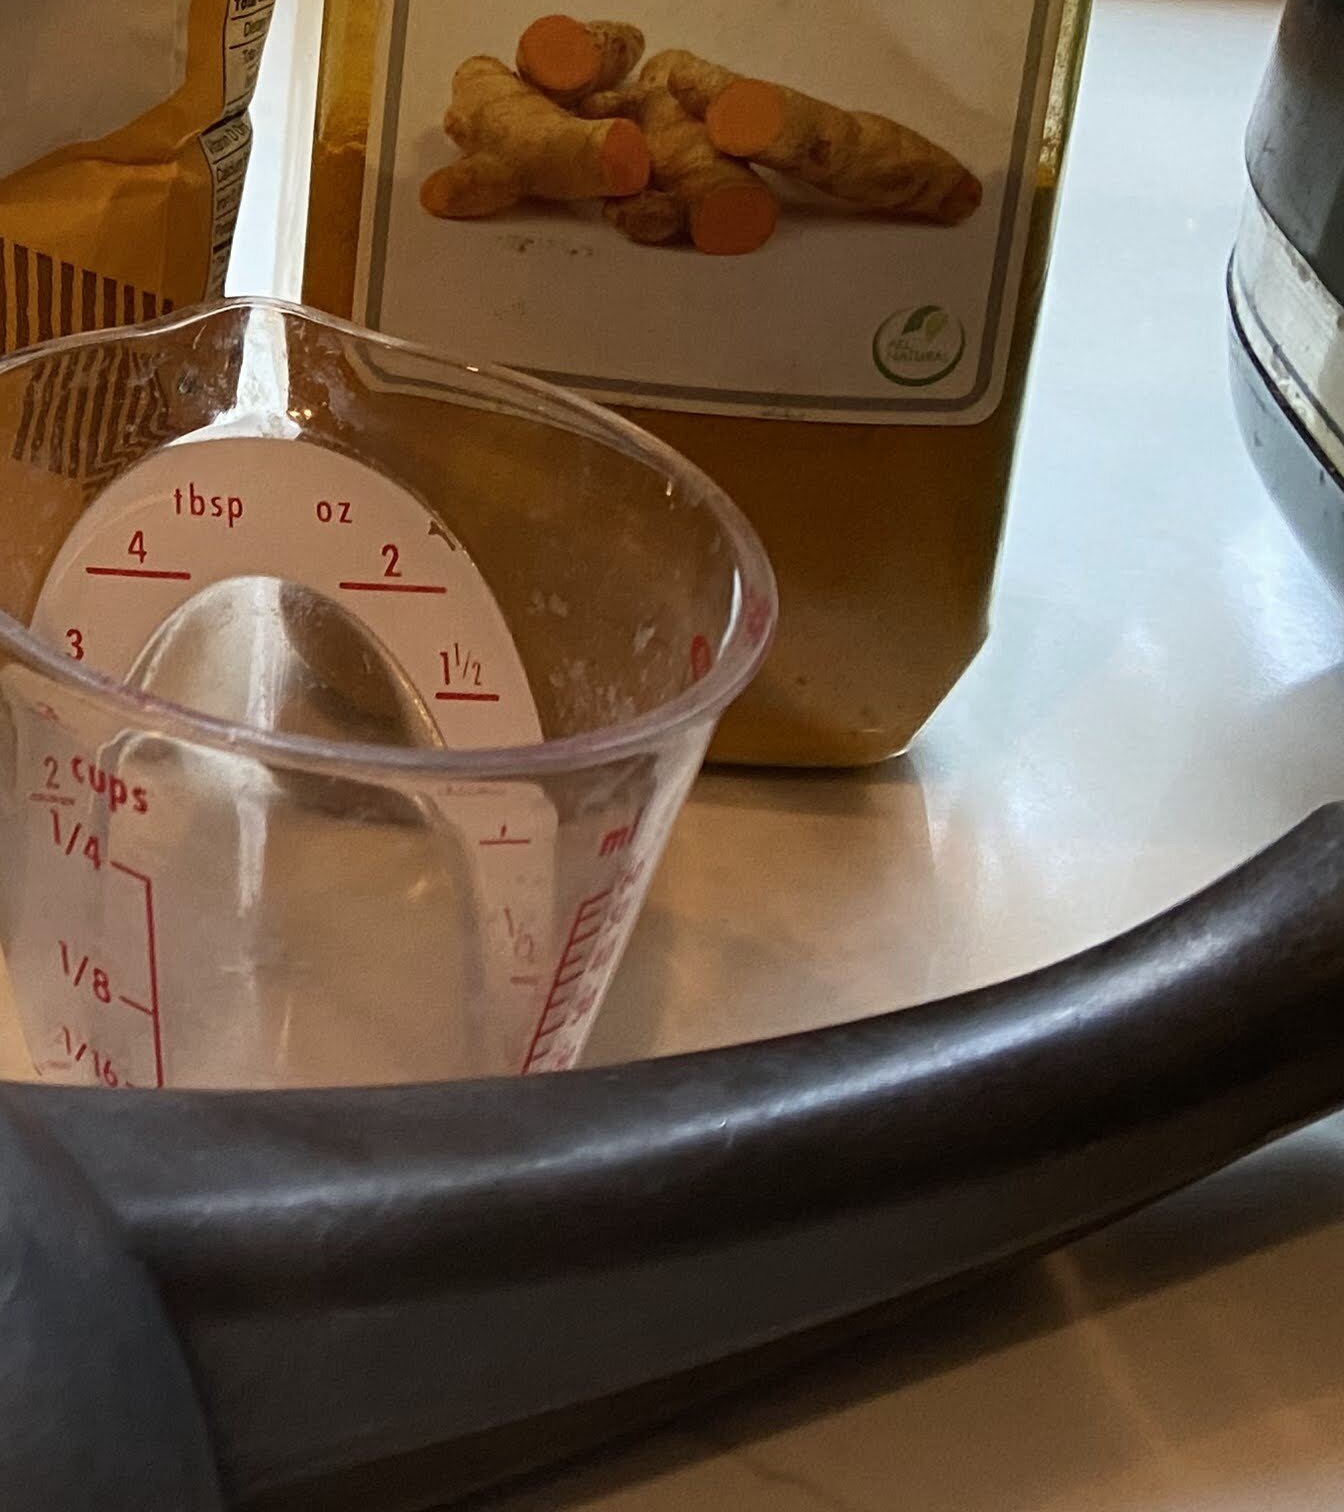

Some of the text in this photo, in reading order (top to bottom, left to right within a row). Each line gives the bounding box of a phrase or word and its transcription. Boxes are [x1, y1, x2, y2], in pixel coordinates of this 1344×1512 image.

[173, 488, 353, 526] tbsp oz
[127, 530, 148, 562] 4
[381, 544, 401, 577] 2
[50, 808, 102, 871] 1/4
[58, 940, 111, 1003] 1/8
